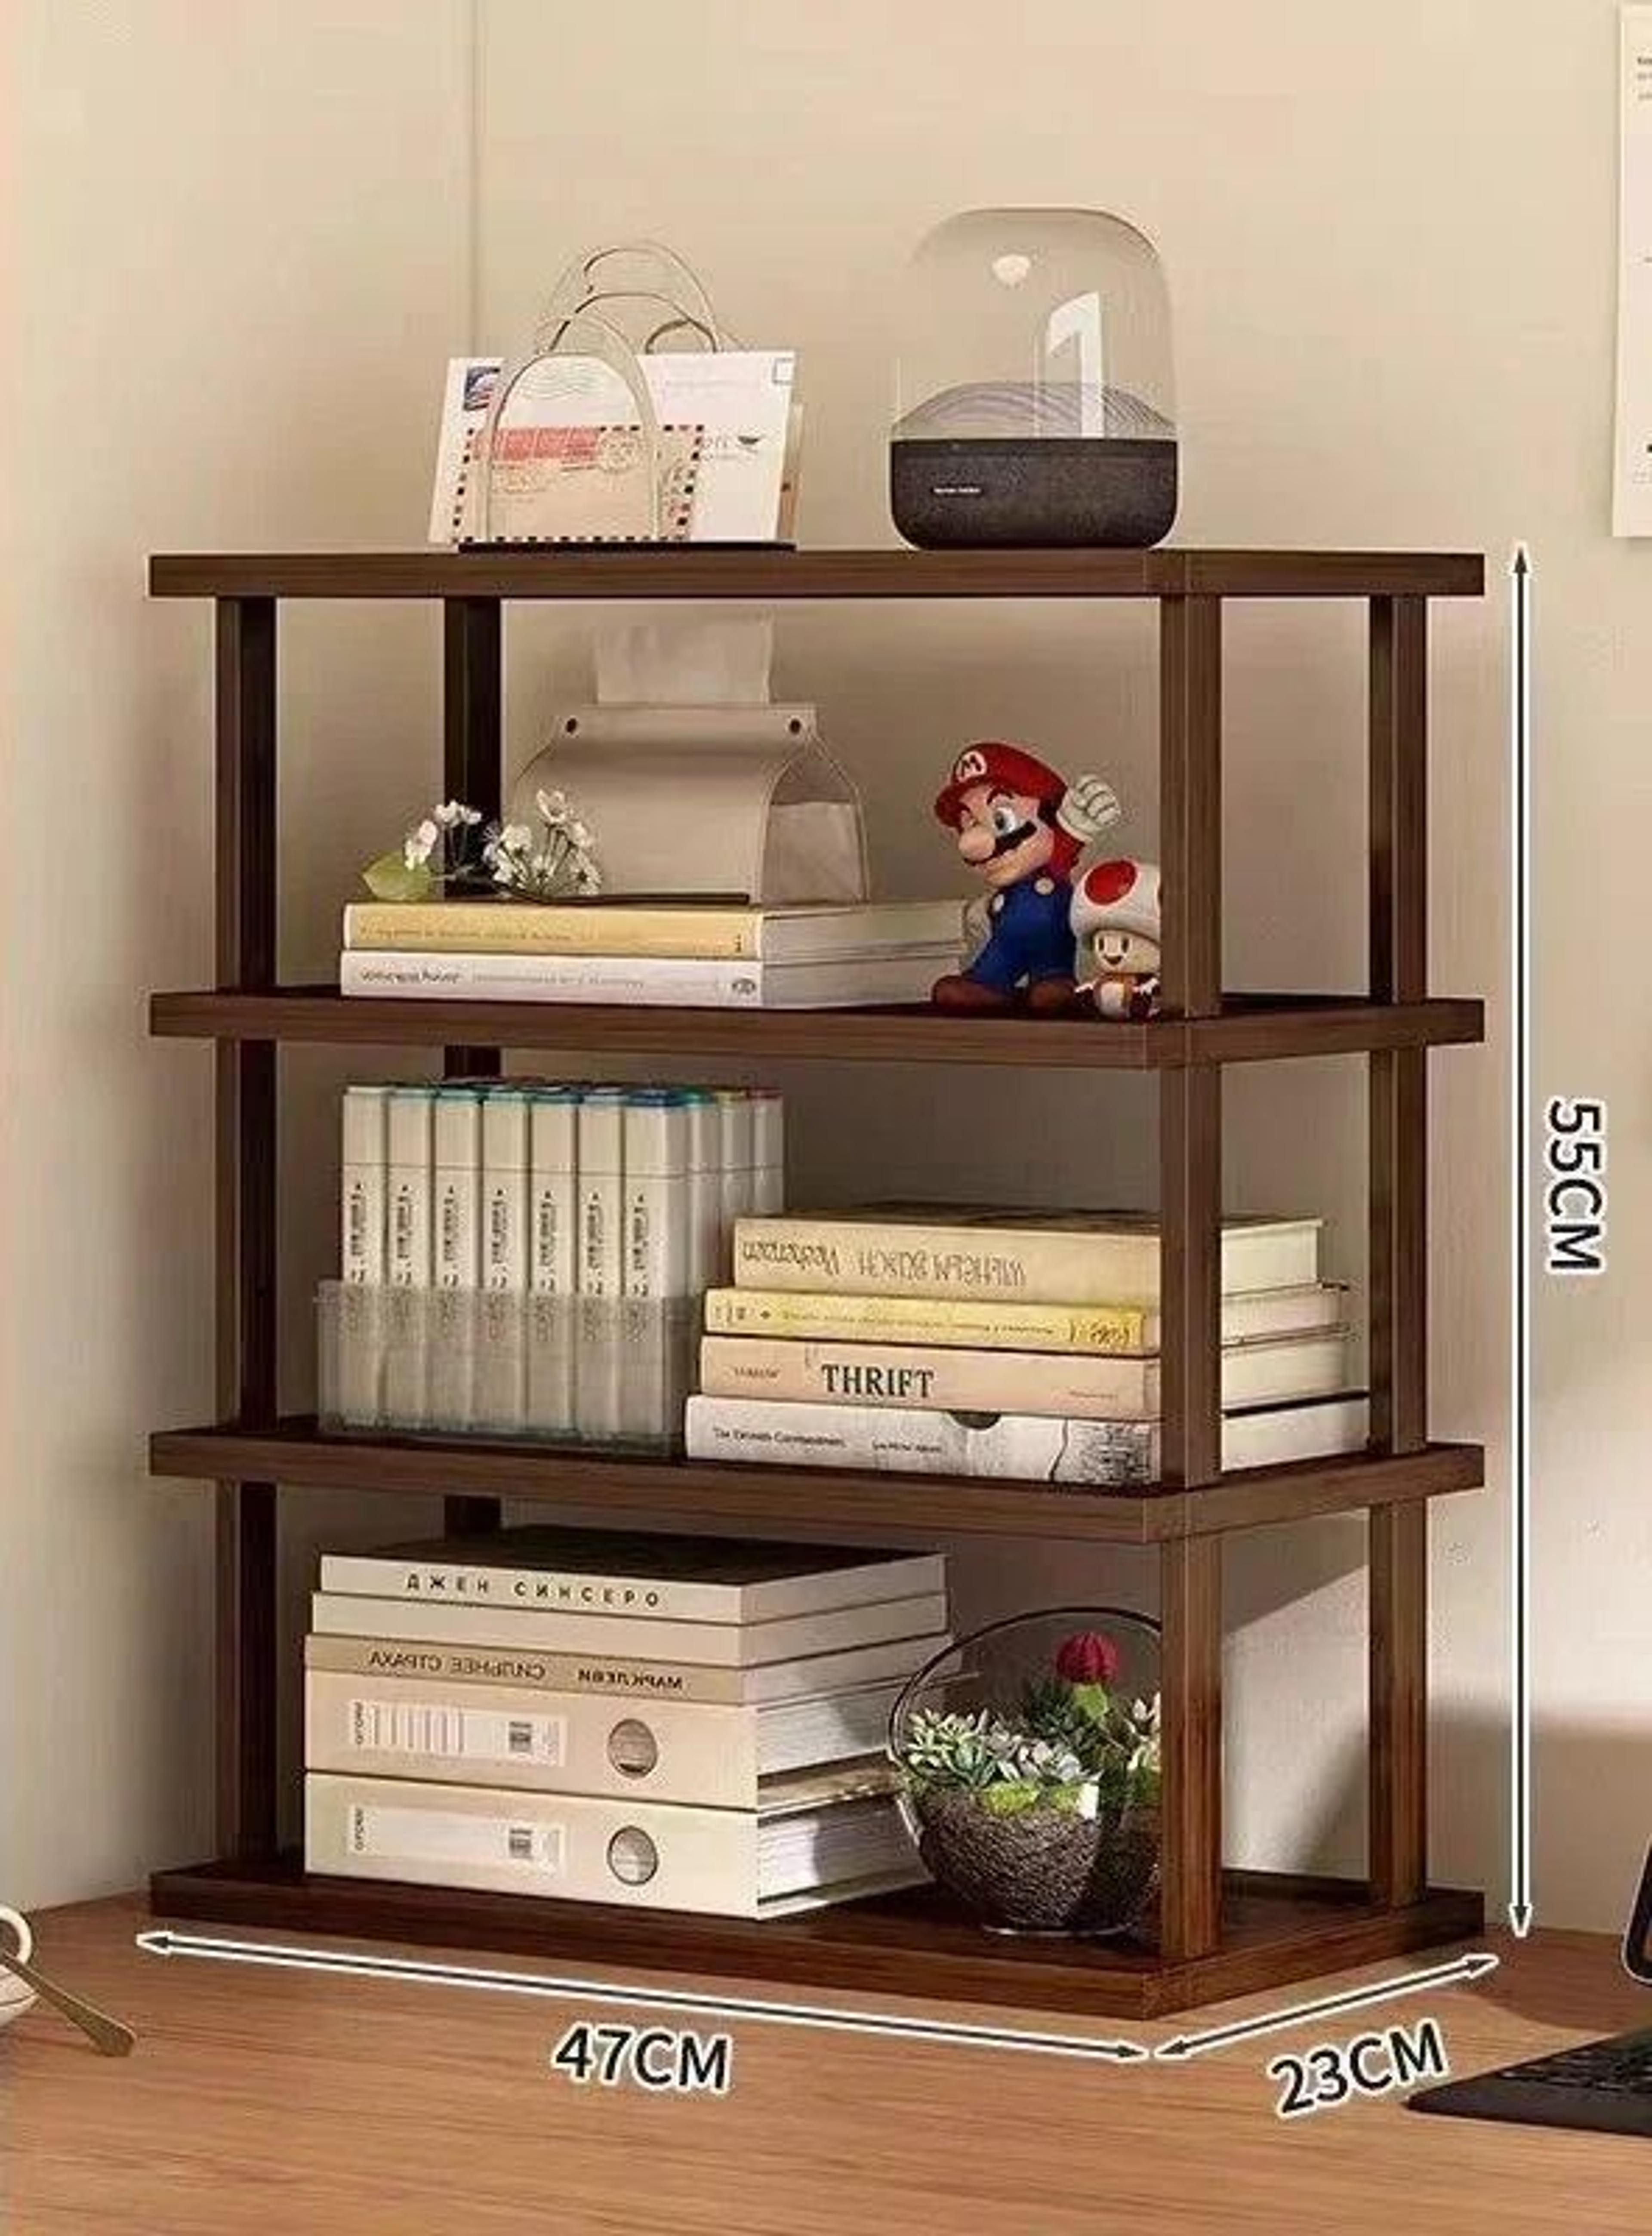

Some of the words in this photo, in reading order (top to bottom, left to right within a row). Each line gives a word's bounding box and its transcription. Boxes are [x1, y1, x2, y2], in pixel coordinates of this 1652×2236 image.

[961, 754, 982, 778] M
[820, 1363, 935, 1398] THRIFT
[407, 1573, 489, 1593] ДЖЕН
[514, 1581, 660, 1607] СИНСЕРО
